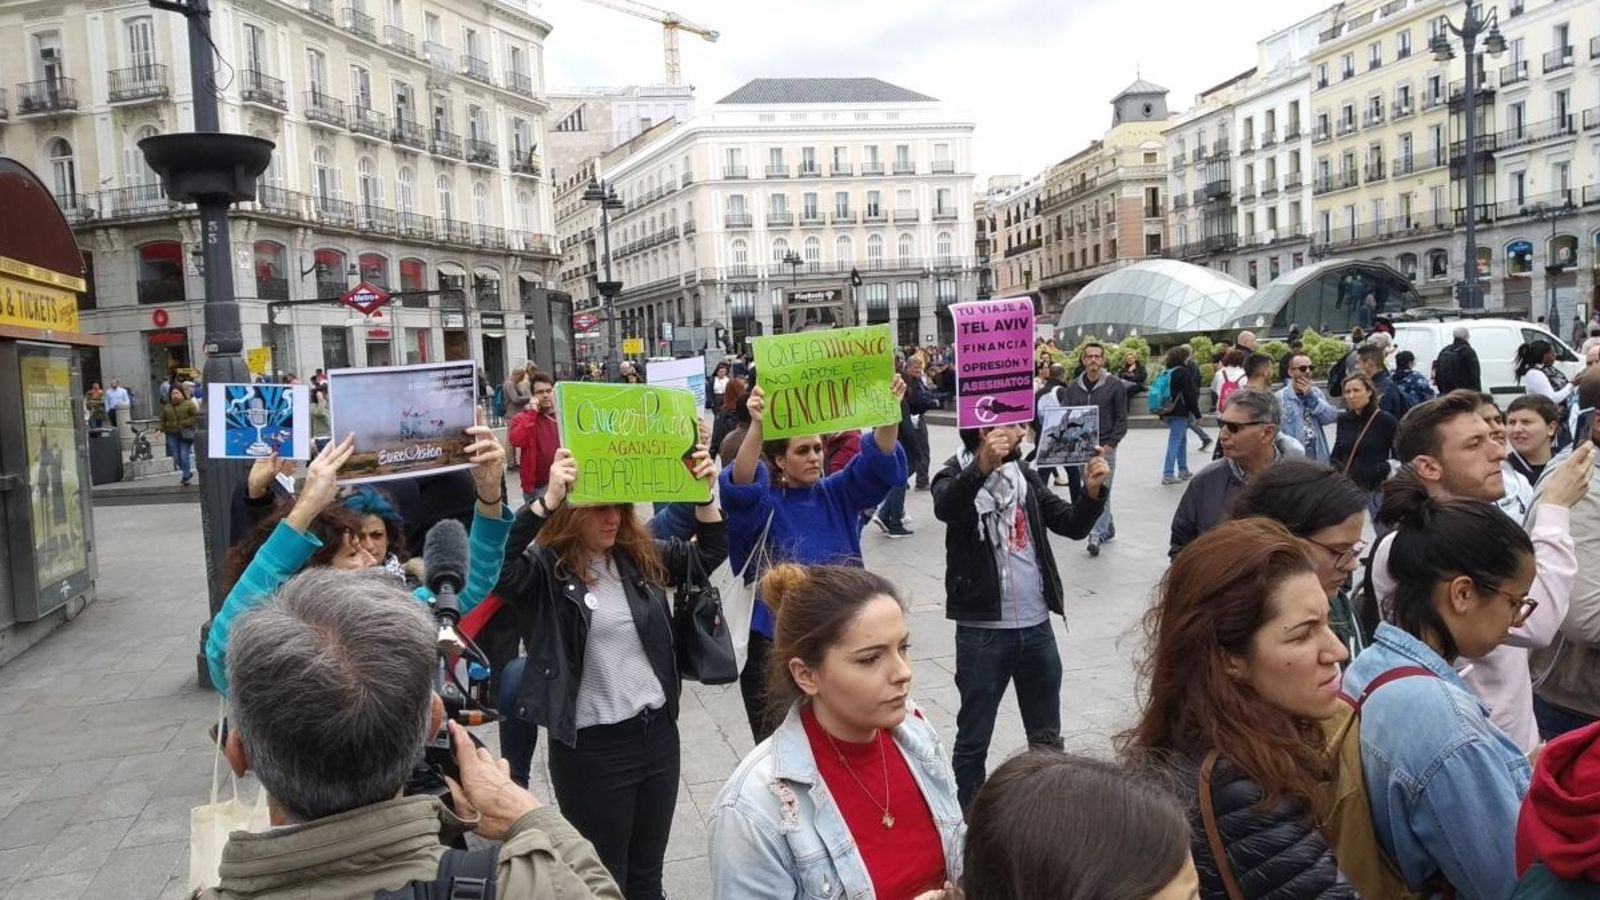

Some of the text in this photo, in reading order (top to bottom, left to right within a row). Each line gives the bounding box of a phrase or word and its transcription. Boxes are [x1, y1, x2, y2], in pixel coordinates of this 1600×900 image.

[6, 287, 15, 317] &
[16, 289, 57, 324] TICKETS
[354, 294, 375, 302] Metro
[958, 302, 1028, 316] TU VIAJE A
[961, 317, 1028, 335] TEL AVIV
[963, 340, 1027, 353] FINANCIA
[764, 373, 791, 385] NO
[852, 361, 875, 372] EL
[962, 358, 1029, 373] OPRESIÓN Y
[962, 375, 1031, 392] ASESINATOS
[608, 441, 667, 455] AGAINST
[583, 457, 686, 496] APARTHEID
